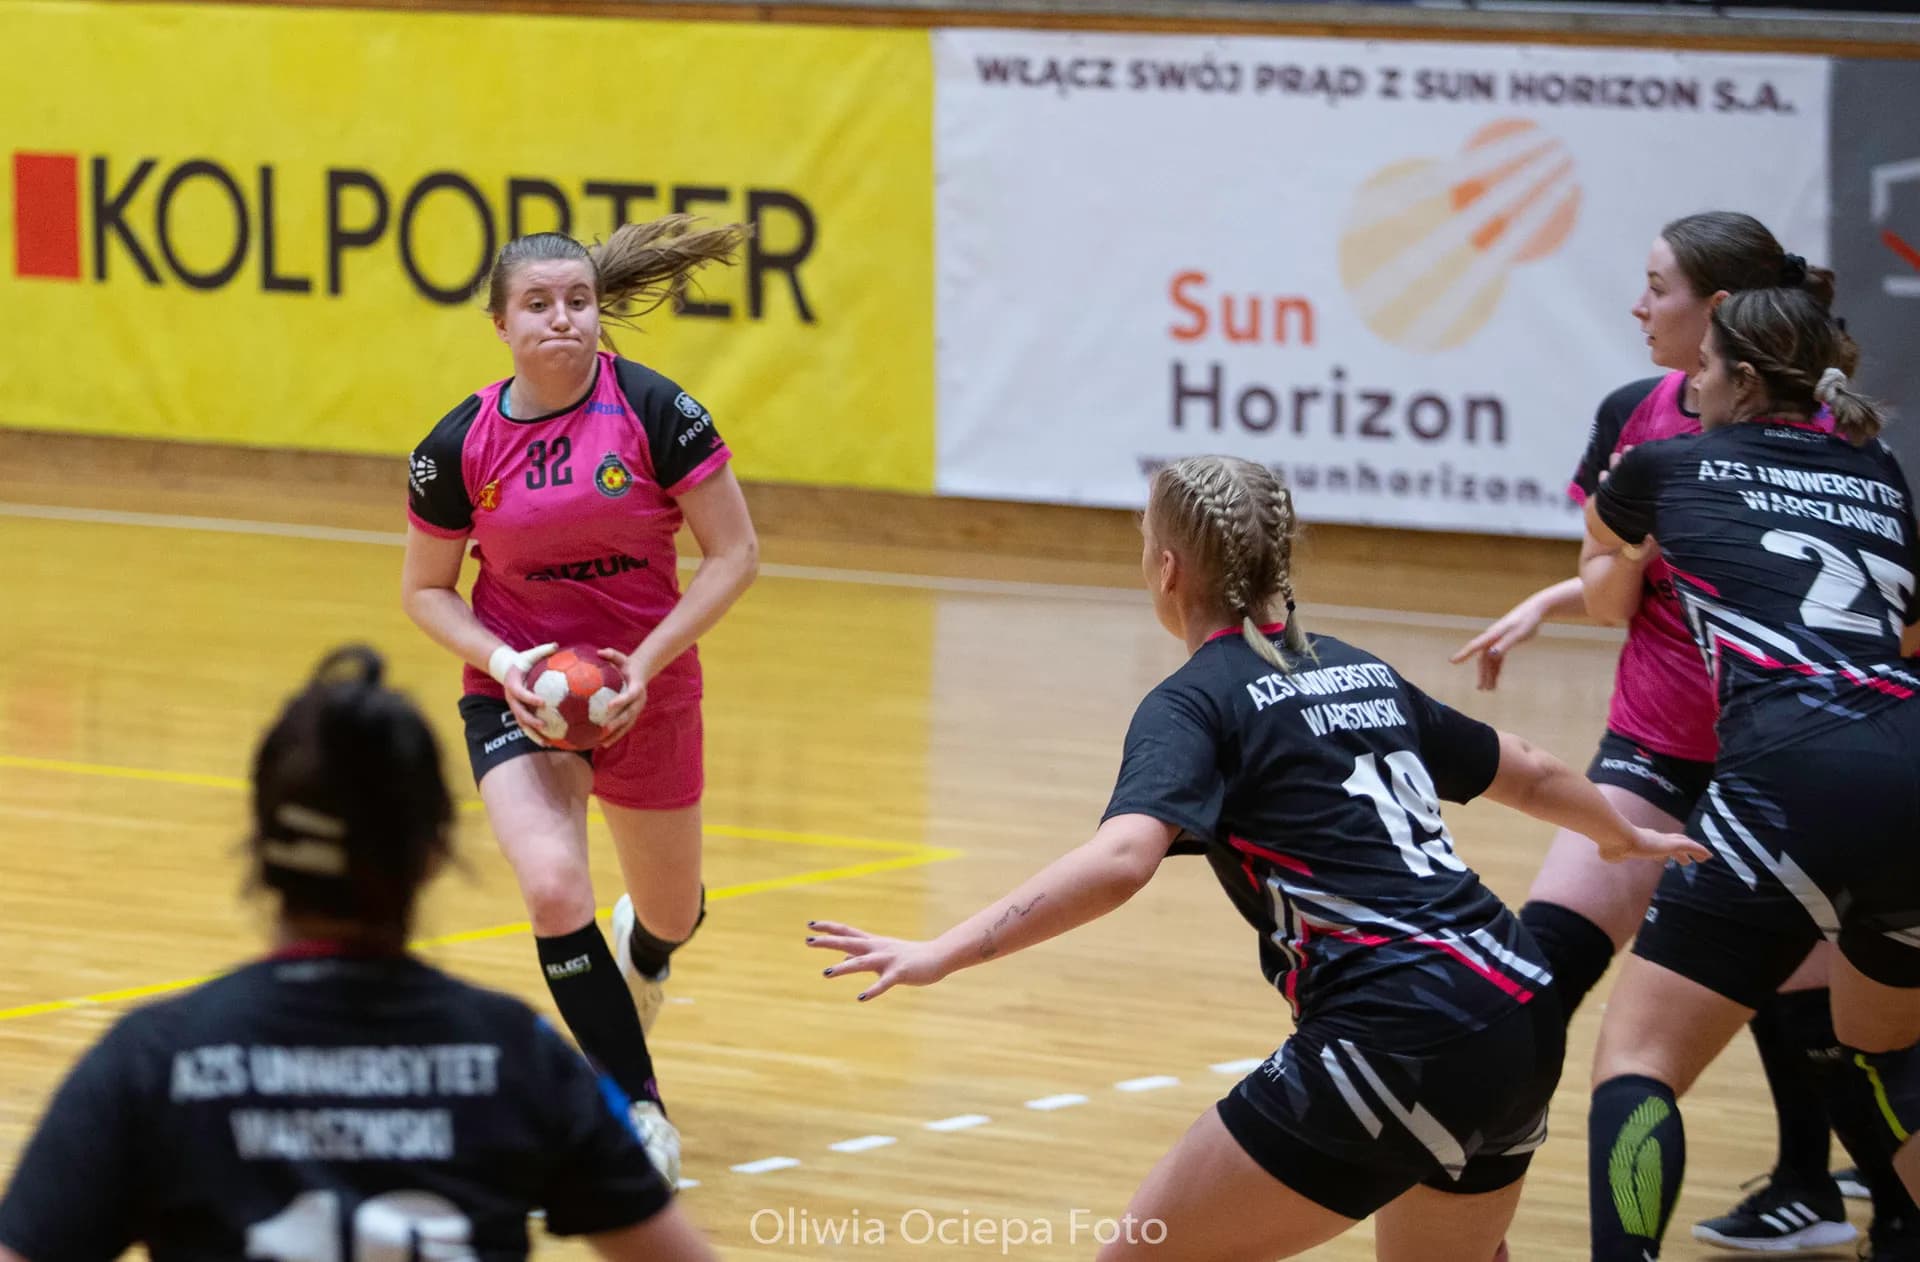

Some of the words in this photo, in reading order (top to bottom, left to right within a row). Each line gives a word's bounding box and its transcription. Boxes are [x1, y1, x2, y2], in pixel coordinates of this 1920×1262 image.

[976, 56, 1114, 98] WŁĄCZ
[1127, 51, 1243, 95] SWÓJ
[1255, 63, 1366, 106] PRĄD
[1378, 68, 1403, 99] Z
[1413, 70, 1495, 102] SUN
[1509, 72, 1700, 112] HORIZON
[1712, 79, 1796, 114] S.A.
[1168, 269, 1316, 346] Sun
[1170, 361, 1508, 444] Horizon
[525, 436, 573, 490] 32
[1698, 460, 1753, 481] AZS
[1756, 466, 1907, 513] UNIWERSYTE
[1246, 673, 1297, 711] AZS
[1284, 663, 1398, 695] UNIWERSYTET
[1341, 750, 1467, 878] 19
